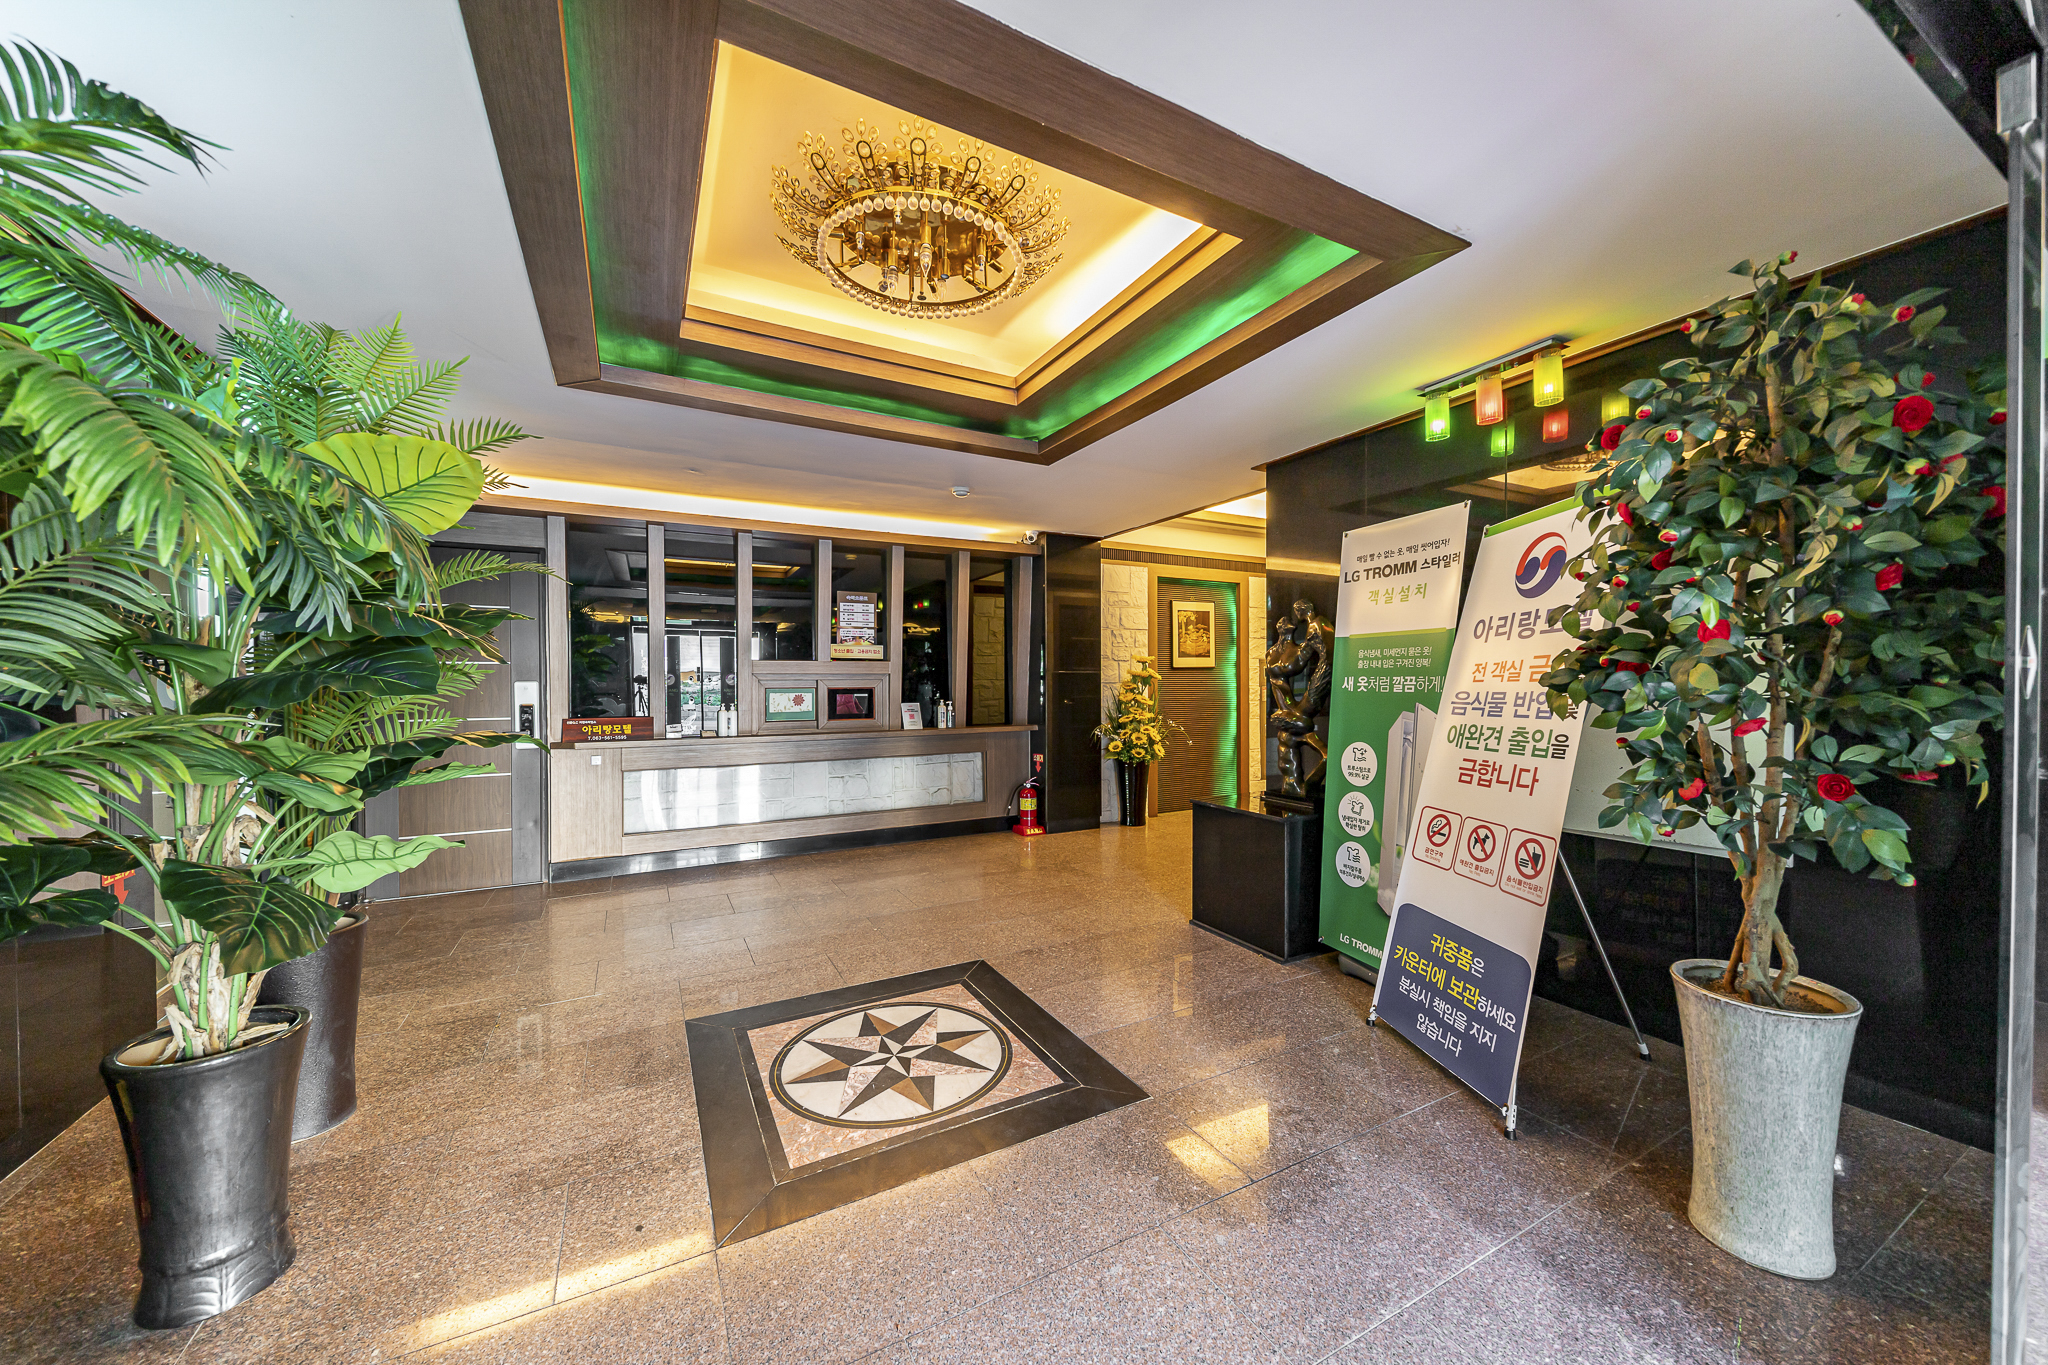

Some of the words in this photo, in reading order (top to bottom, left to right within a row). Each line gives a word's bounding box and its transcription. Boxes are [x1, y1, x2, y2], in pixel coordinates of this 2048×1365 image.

[1356, 554, 1368, 563] 매일
[1369, 553, 1375, 562] 빨
[1384, 550, 1396, 559] 없는
[1396, 548, 1404, 556] 옷,
[1406, 544, 1419, 553] 매일
[1420, 538, 1450, 552] 씻어입자!
[1344, 570, 1360, 583] LG
[1363, 560, 1418, 581] TROMM
[1420, 551, 1461, 569] 스타일러
[1358, 660, 1369, 669] 출장
[1370, 659, 1381, 668] 내내
[1383, 659, 1394, 668] 입은
[1396, 659, 1414, 668] 구겨진
[1416, 658, 1431, 667] 양복!
[1383, 648, 1407, 657] 미세먼지
[1408, 646, 1421, 656] 묻은
[1422, 646, 1432, 656] 옷!
[1472, 662, 1488, 683] 전
[1490, 659, 1524, 683] 객실
[1342, 676, 1354, 692] 새
[1357, 676, 1390, 692] 옷처럼
[1392, 676, 1445, 693] 깔끔하게!
[1450, 691, 1507, 718] 음식물
[1513, 691, 1555, 720] 반입
[582, 724, 632, 735] 아리랑모텔
[1447, 723, 1504, 752] 애완견
[1507, 726, 1569, 760] 출입을
[1457, 758, 1539, 796] 금합니다
[1424, 847, 1444, 858] 금연구역
[1474, 864, 1495, 877] 출입금지
[1506, 875, 1544, 894] 음식물반입금지
[1340, 933, 1349, 944] LG
[1351, 938, 1383, 959] TROMM
[1430, 933, 1484, 978] 귀중품은
[1393, 945, 1447, 991] 카운터에
[1447, 976, 1517, 1033] 보관하세요
[1399, 976, 1431, 1008] 분실시
[1432, 997, 1468, 1033] 책임을
[1470, 1022, 1497, 1053] 지지
[1416, 1013, 1462, 1057] 않습니다
